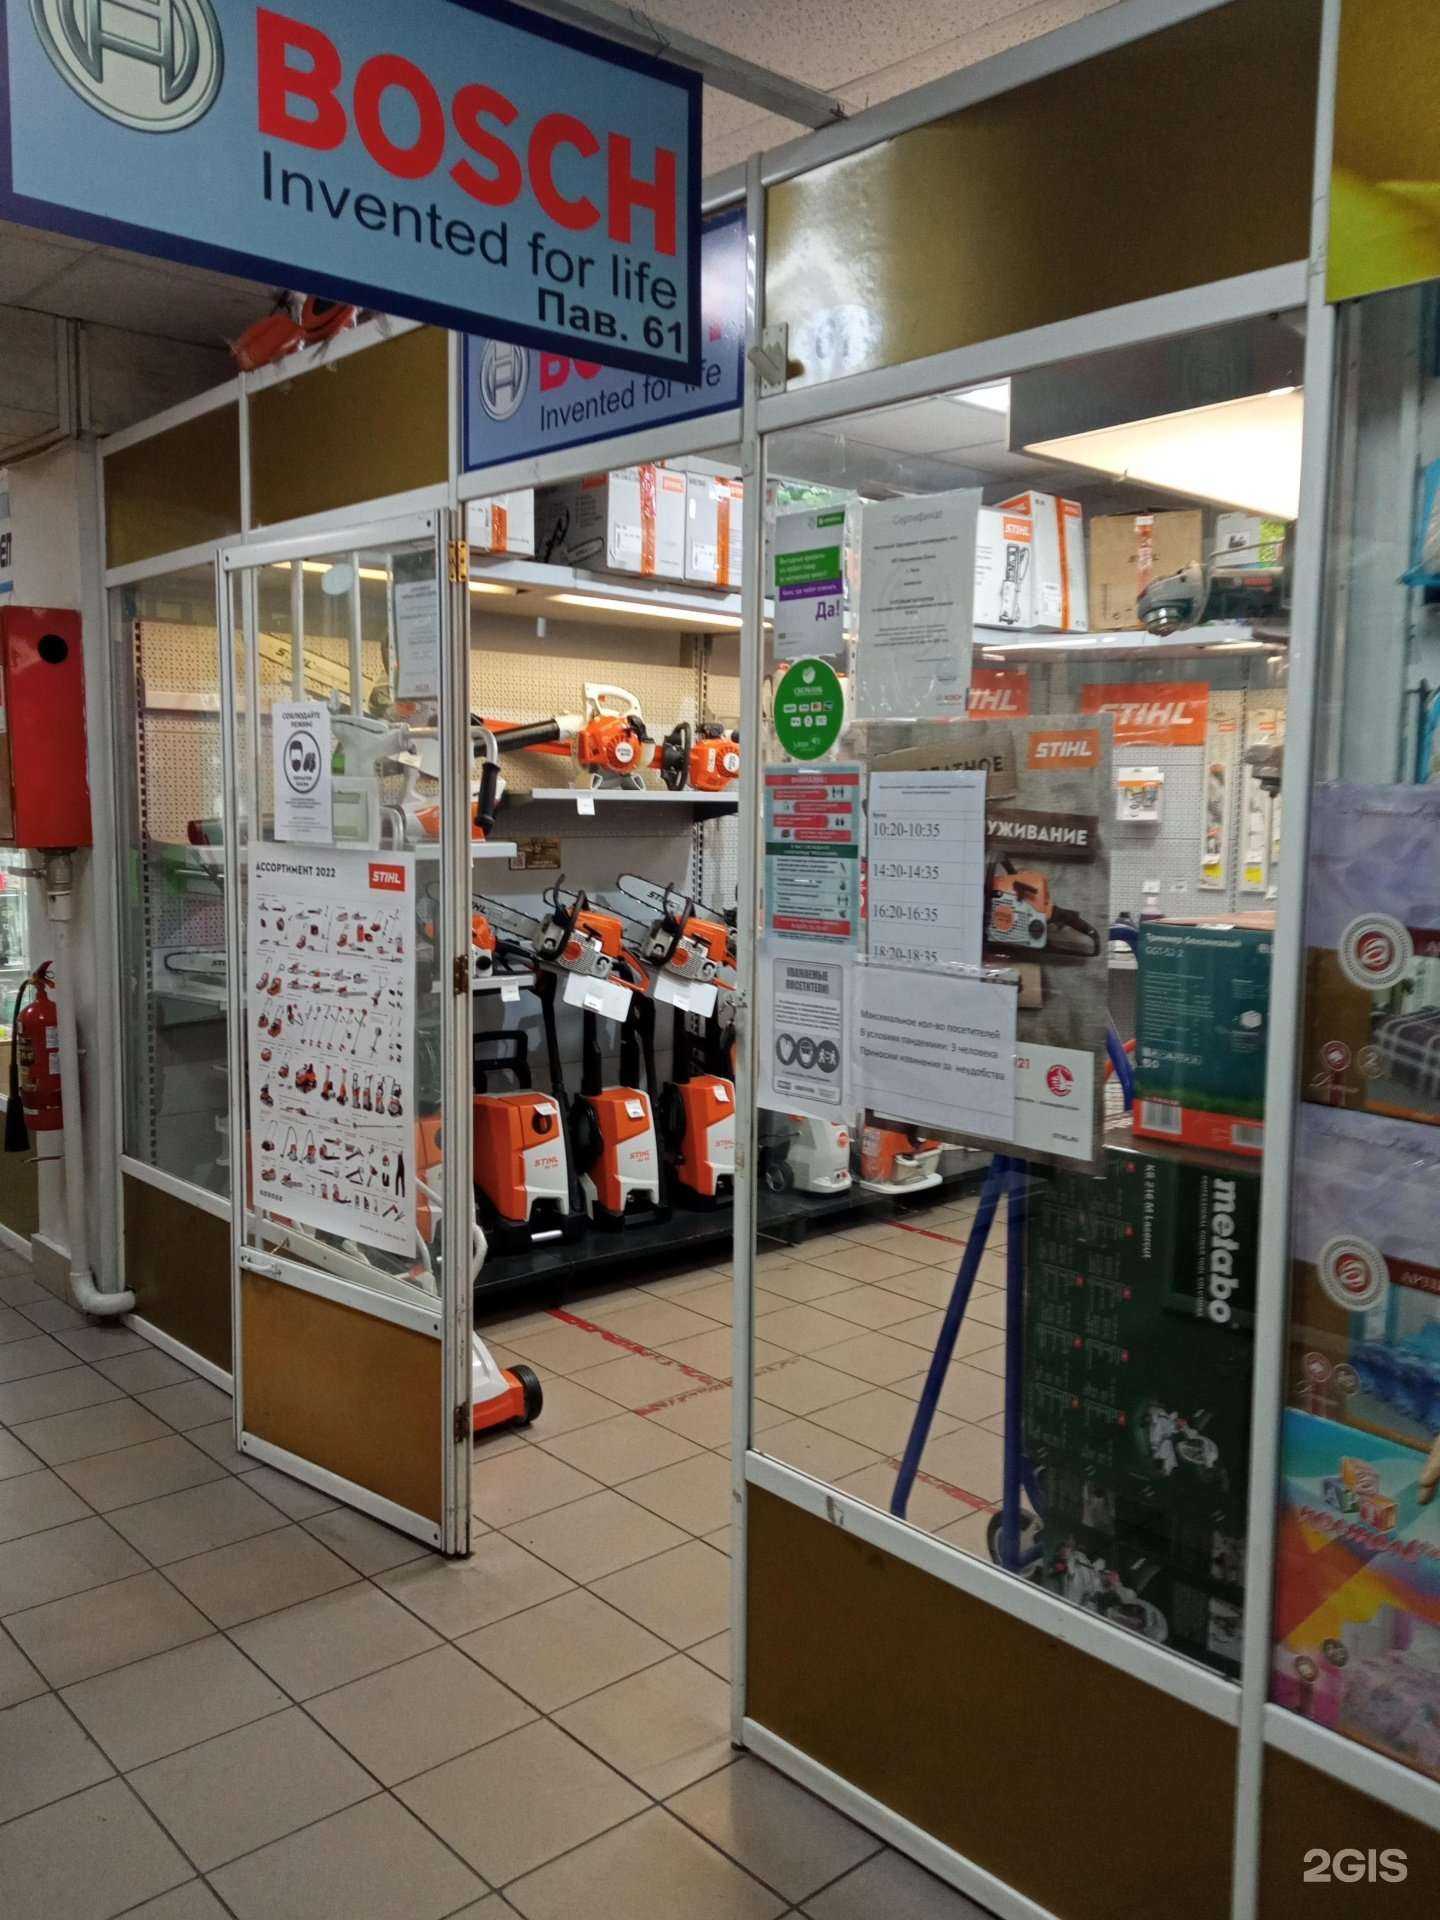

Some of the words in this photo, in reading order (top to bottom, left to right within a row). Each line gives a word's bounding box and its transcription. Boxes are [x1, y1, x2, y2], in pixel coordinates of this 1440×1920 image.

[256, 6, 677, 256] BOSCH
[262, 151, 508, 267] Invented
[528, 233, 594, 287] for
[611, 253, 678, 311] life
[537, 287, 628, 341] Пав.
[643, 316, 684, 355] 61
[540, 381, 634, 432] Invented
[1005, 525, 1030, 537] STIHL
[815, 601, 840, 621] Да!
[1035, 741, 1093, 758] STIHL
[873, 822, 940, 838] 10:20-10:35
[987, 820, 1089, 846] УЖИВАНИЕ
[316, 867, 336, 878] 2022
[372, 871, 401, 884] STIHL
[873, 864, 940, 880] 14:20-14:35
[873, 904, 938, 921] 16:20-16:35
[873, 945, 938, 961] 18:20-18:35
[860, 1009, 916, 1027] Максимальное
[1209, 1178, 1240, 1323] metabo
